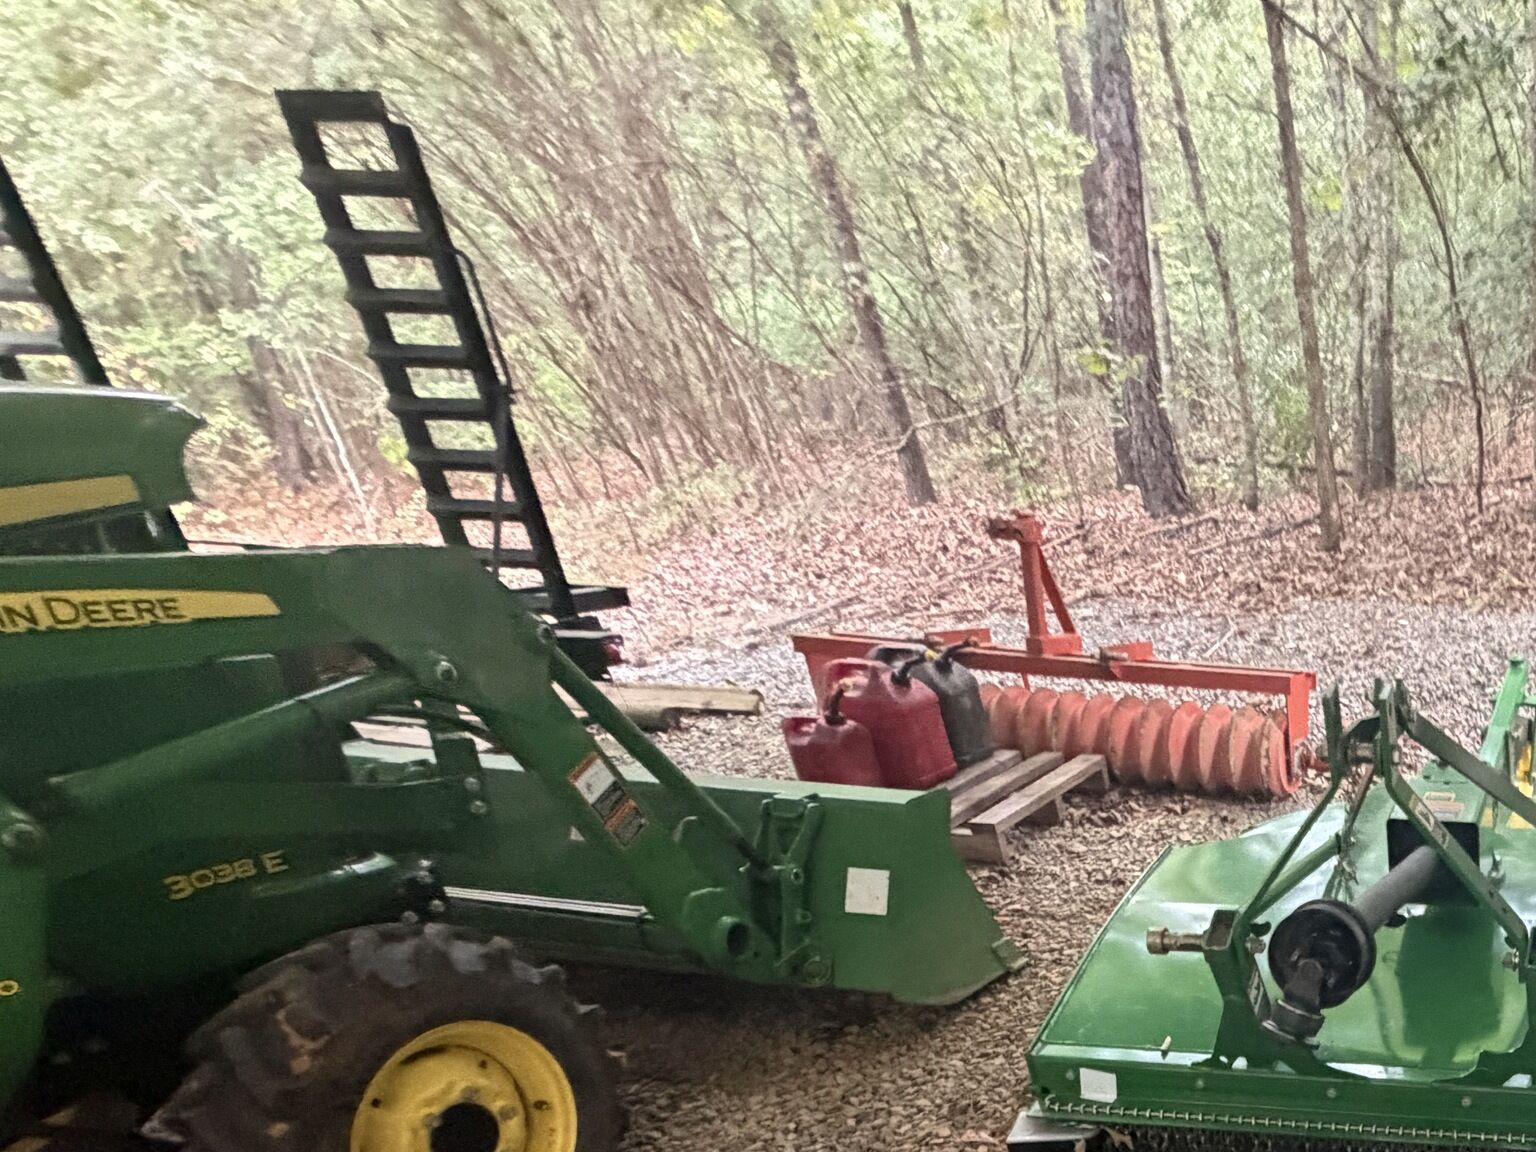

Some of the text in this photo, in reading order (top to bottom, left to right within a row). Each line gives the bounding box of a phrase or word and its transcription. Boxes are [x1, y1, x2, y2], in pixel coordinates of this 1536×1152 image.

[42, 595, 188, 625] DEERE
[163, 850, 289, 900] 3038 E
